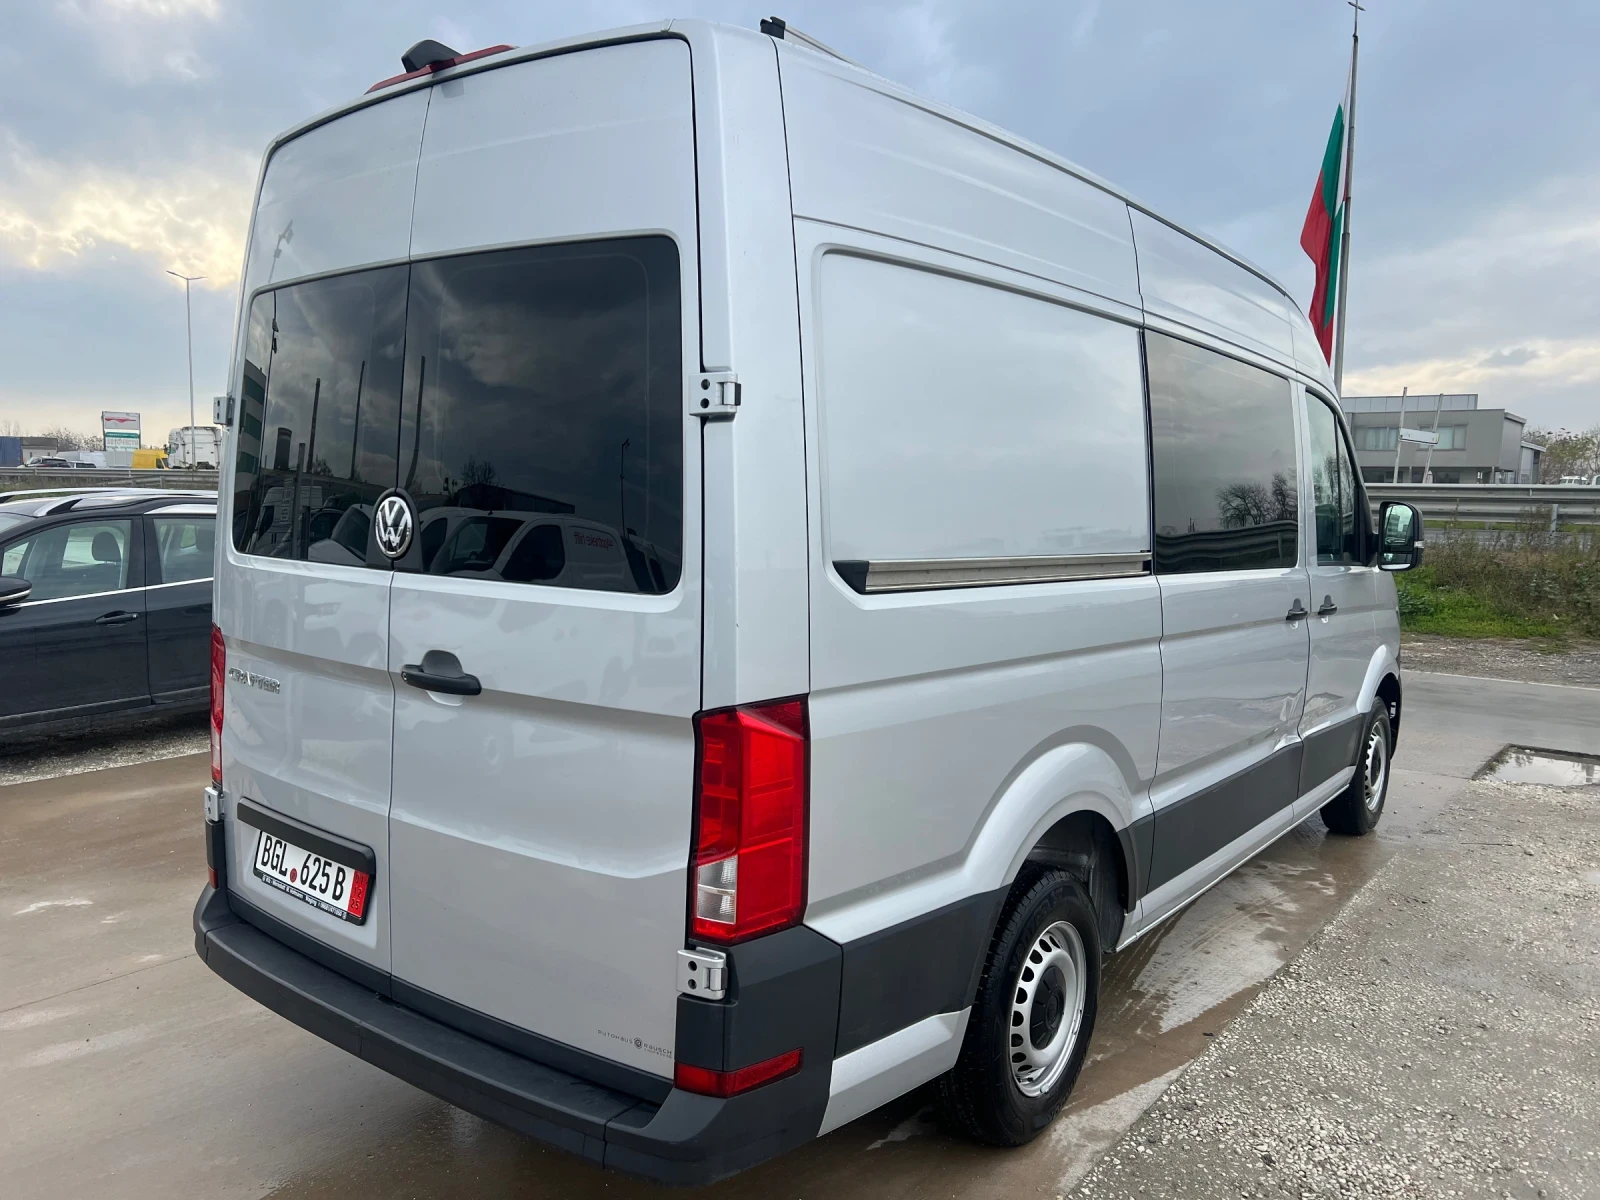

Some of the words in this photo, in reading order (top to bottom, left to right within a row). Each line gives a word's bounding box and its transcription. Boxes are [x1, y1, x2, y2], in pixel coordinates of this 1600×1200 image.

[261, 835, 288, 877] BGL
[300, 853, 332, 895] 625
[332, 866, 346, 901] B
[353, 885, 362, 897] 12
[350, 898, 359, 910] 25
